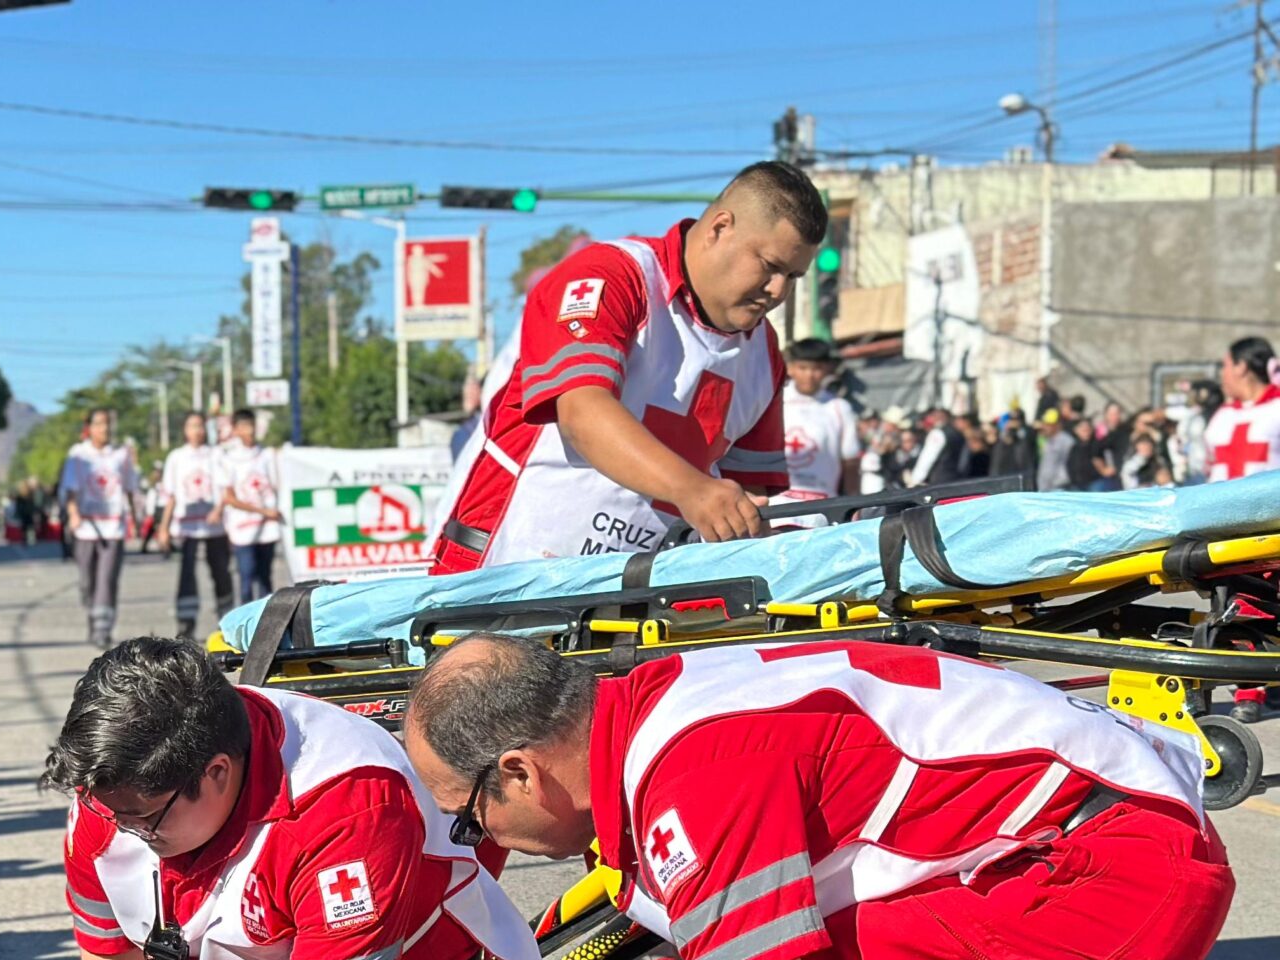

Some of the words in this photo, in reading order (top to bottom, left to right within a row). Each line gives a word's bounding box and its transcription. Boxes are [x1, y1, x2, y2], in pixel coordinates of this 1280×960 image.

[329, 471, 342, 482] A
[592, 512, 656, 550] CRUZ
[344, 699, 408, 716] MX-P
[662, 857, 688, 884] MEXICANA
[332, 903, 349, 913] CRUZ
[349, 899, 366, 908] ROJA
[334, 905, 367, 919] MEXICANA
